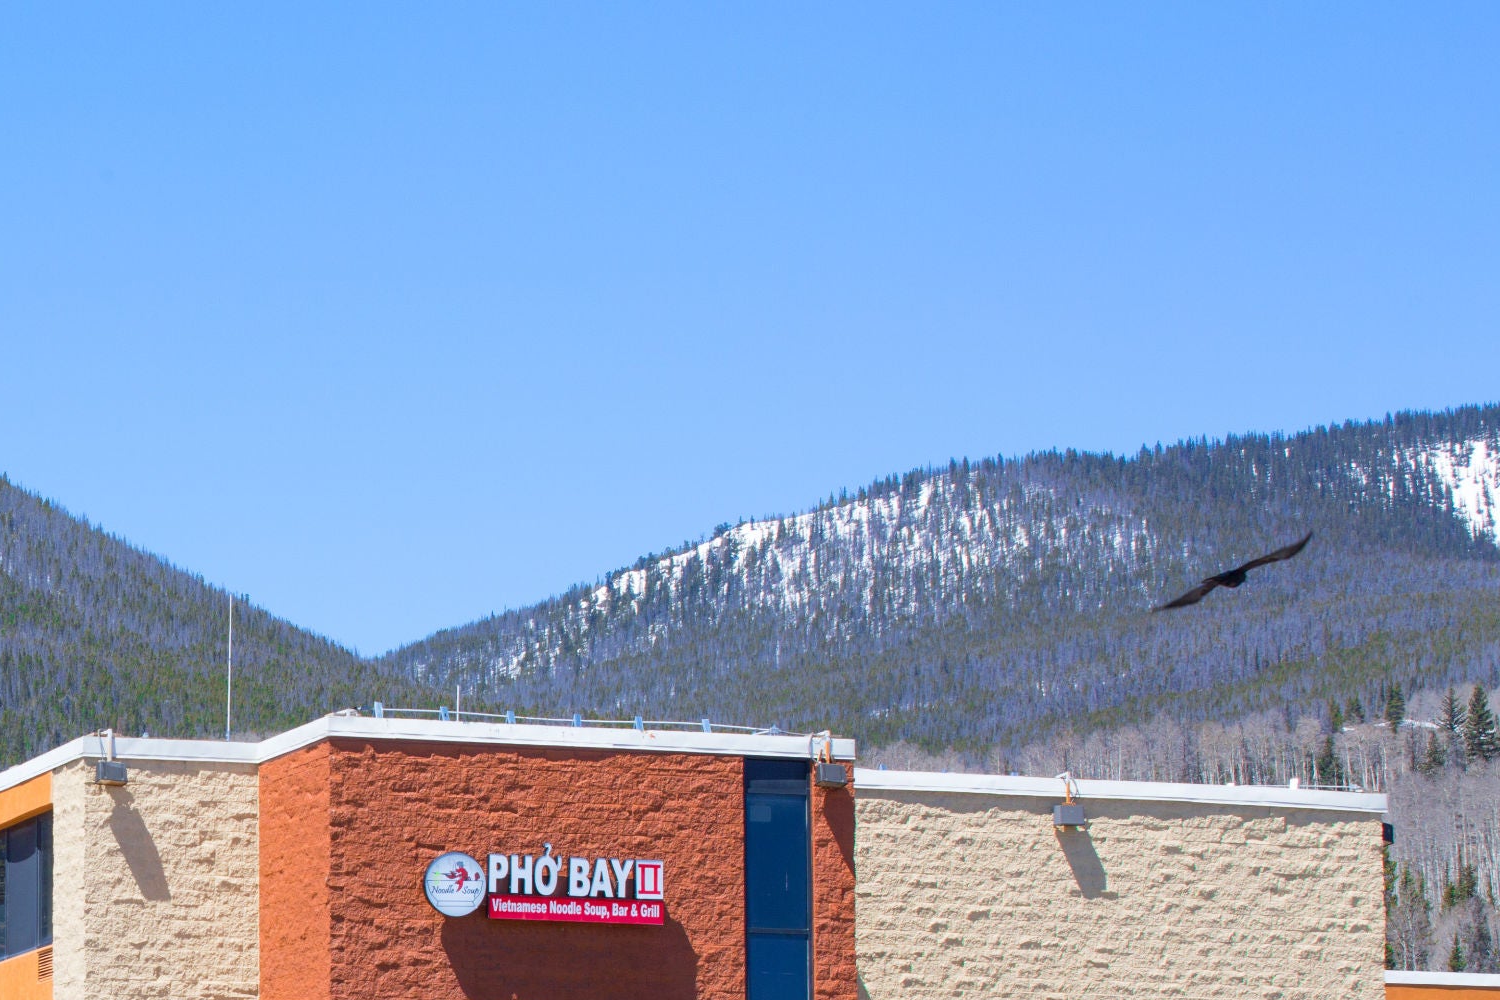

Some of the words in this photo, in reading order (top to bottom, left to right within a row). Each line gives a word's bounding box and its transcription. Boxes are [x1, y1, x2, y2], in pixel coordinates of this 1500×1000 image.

[568, 856, 634, 899] BAY
[431, 884, 455, 894] Noodle
[462, 886, 479, 900] Soup
[492, 898, 547, 914] Vietnamese
[549, 900, 582, 915] Noodle
[584, 902, 610, 919] Soup,
[612, 902, 628, 917] Bar
[630, 903, 638, 917] &
[640, 904, 660, 918] Grill
